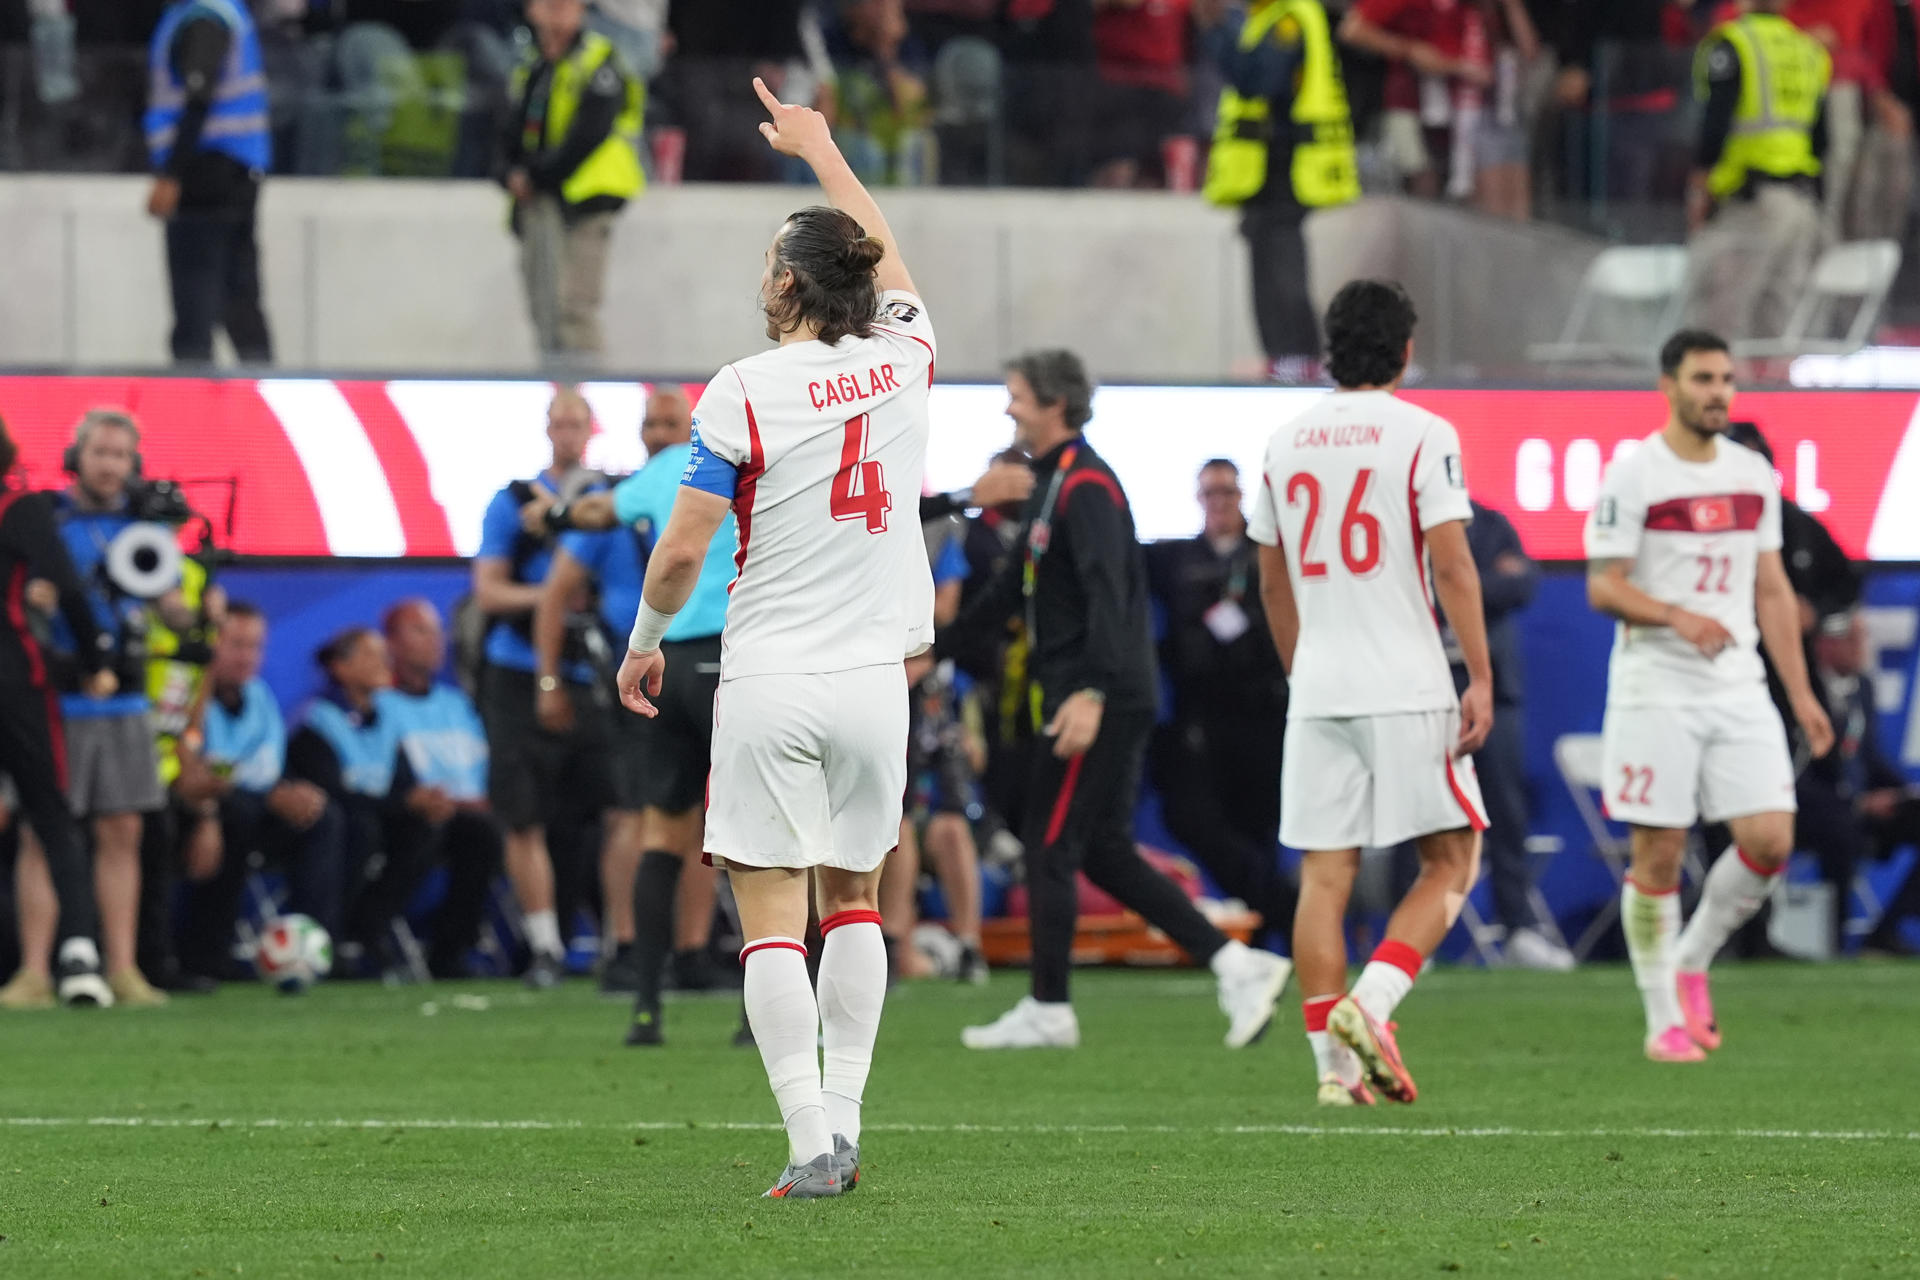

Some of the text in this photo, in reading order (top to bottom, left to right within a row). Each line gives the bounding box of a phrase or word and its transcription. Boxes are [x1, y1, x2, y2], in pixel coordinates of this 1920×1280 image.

[808, 363, 901, 412] ÇAĞLAR
[1293, 424, 1384, 448] CAN UZUN
[829, 411, 892, 535] 4
[1286, 466, 1387, 582] 26
[1694, 555, 1732, 594] 22
[1618, 763, 1655, 806] 22
